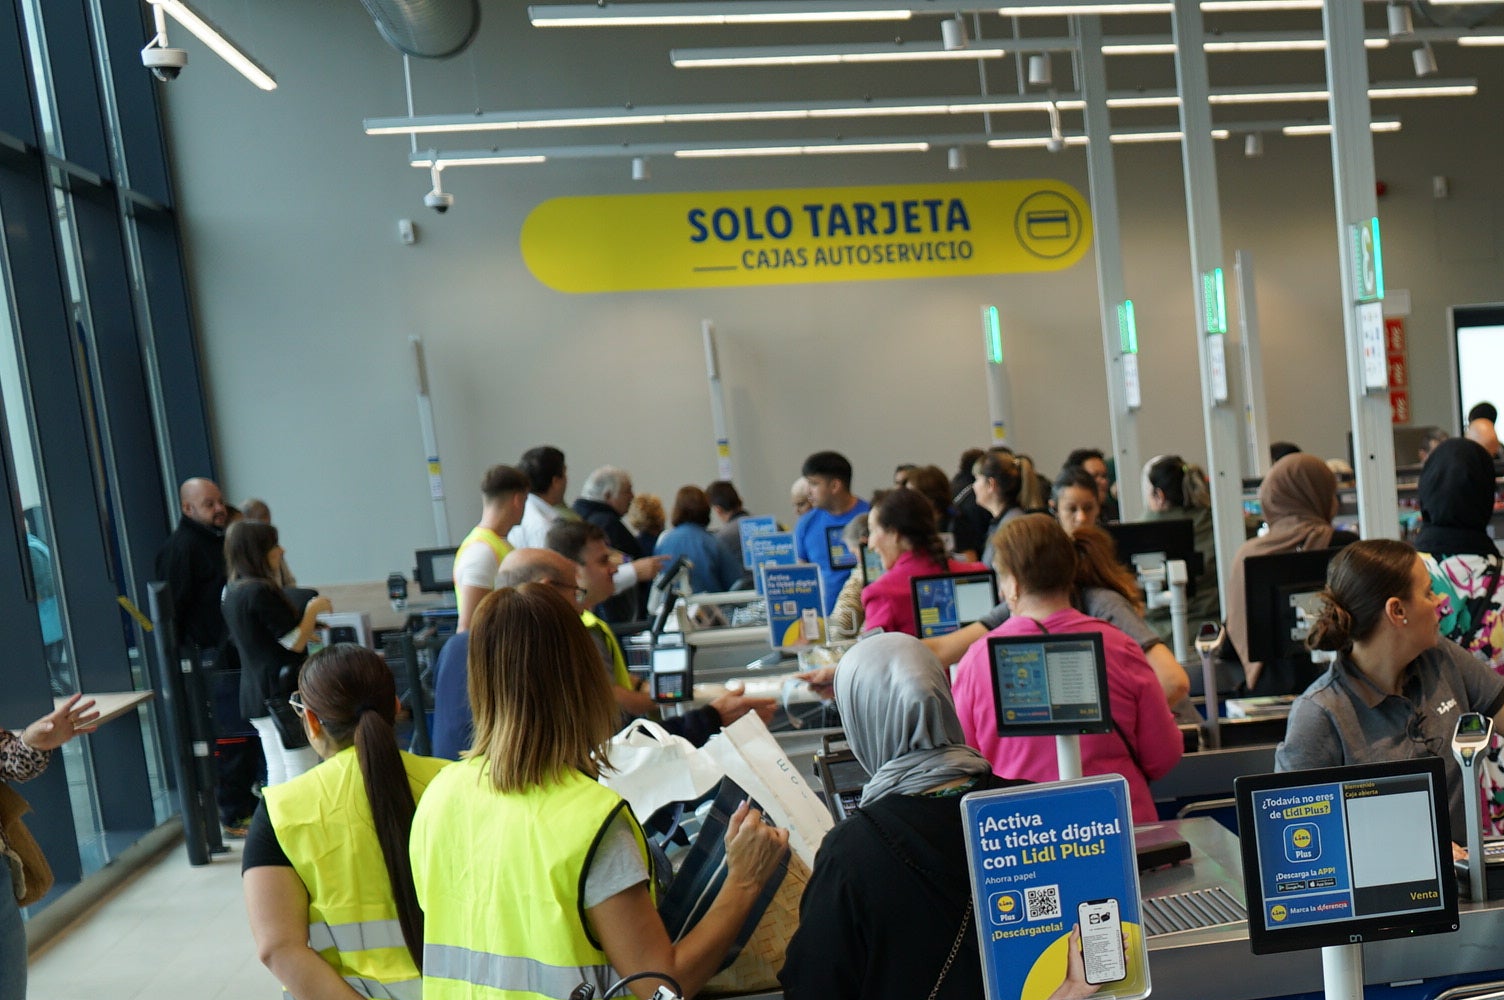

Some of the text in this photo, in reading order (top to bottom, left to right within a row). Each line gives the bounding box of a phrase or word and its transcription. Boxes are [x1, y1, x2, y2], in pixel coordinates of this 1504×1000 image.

[687, 198, 971, 243] SOLO TARJETA
[742, 240, 973, 270] CAJAS AUTOSERVICIO
[1262, 795, 1301, 809] ¿Todavía
[1315, 793, 1335, 801] eres
[1345, 788, 1379, 798] Caja abierta
[1269, 805, 1330, 820] de Lidl Plus?
[979, 812, 1042, 837] ¡Activa
[980, 818, 1121, 852] tu ticket digital
[983, 839, 1105, 870] con Lidl Plus!
[1296, 849, 1312, 859] Plus
[985, 871, 1037, 885] Ahorra papel
[1275, 870, 1310, 882] ¡Descarga
[1317, 866, 1336, 876] APP!
[1410, 890, 1438, 900] Venta
[1000, 912, 1016, 921] Plus
[1290, 906, 1310, 915] Marca
[991, 922, 1064, 942] ¡Descárgatela!
